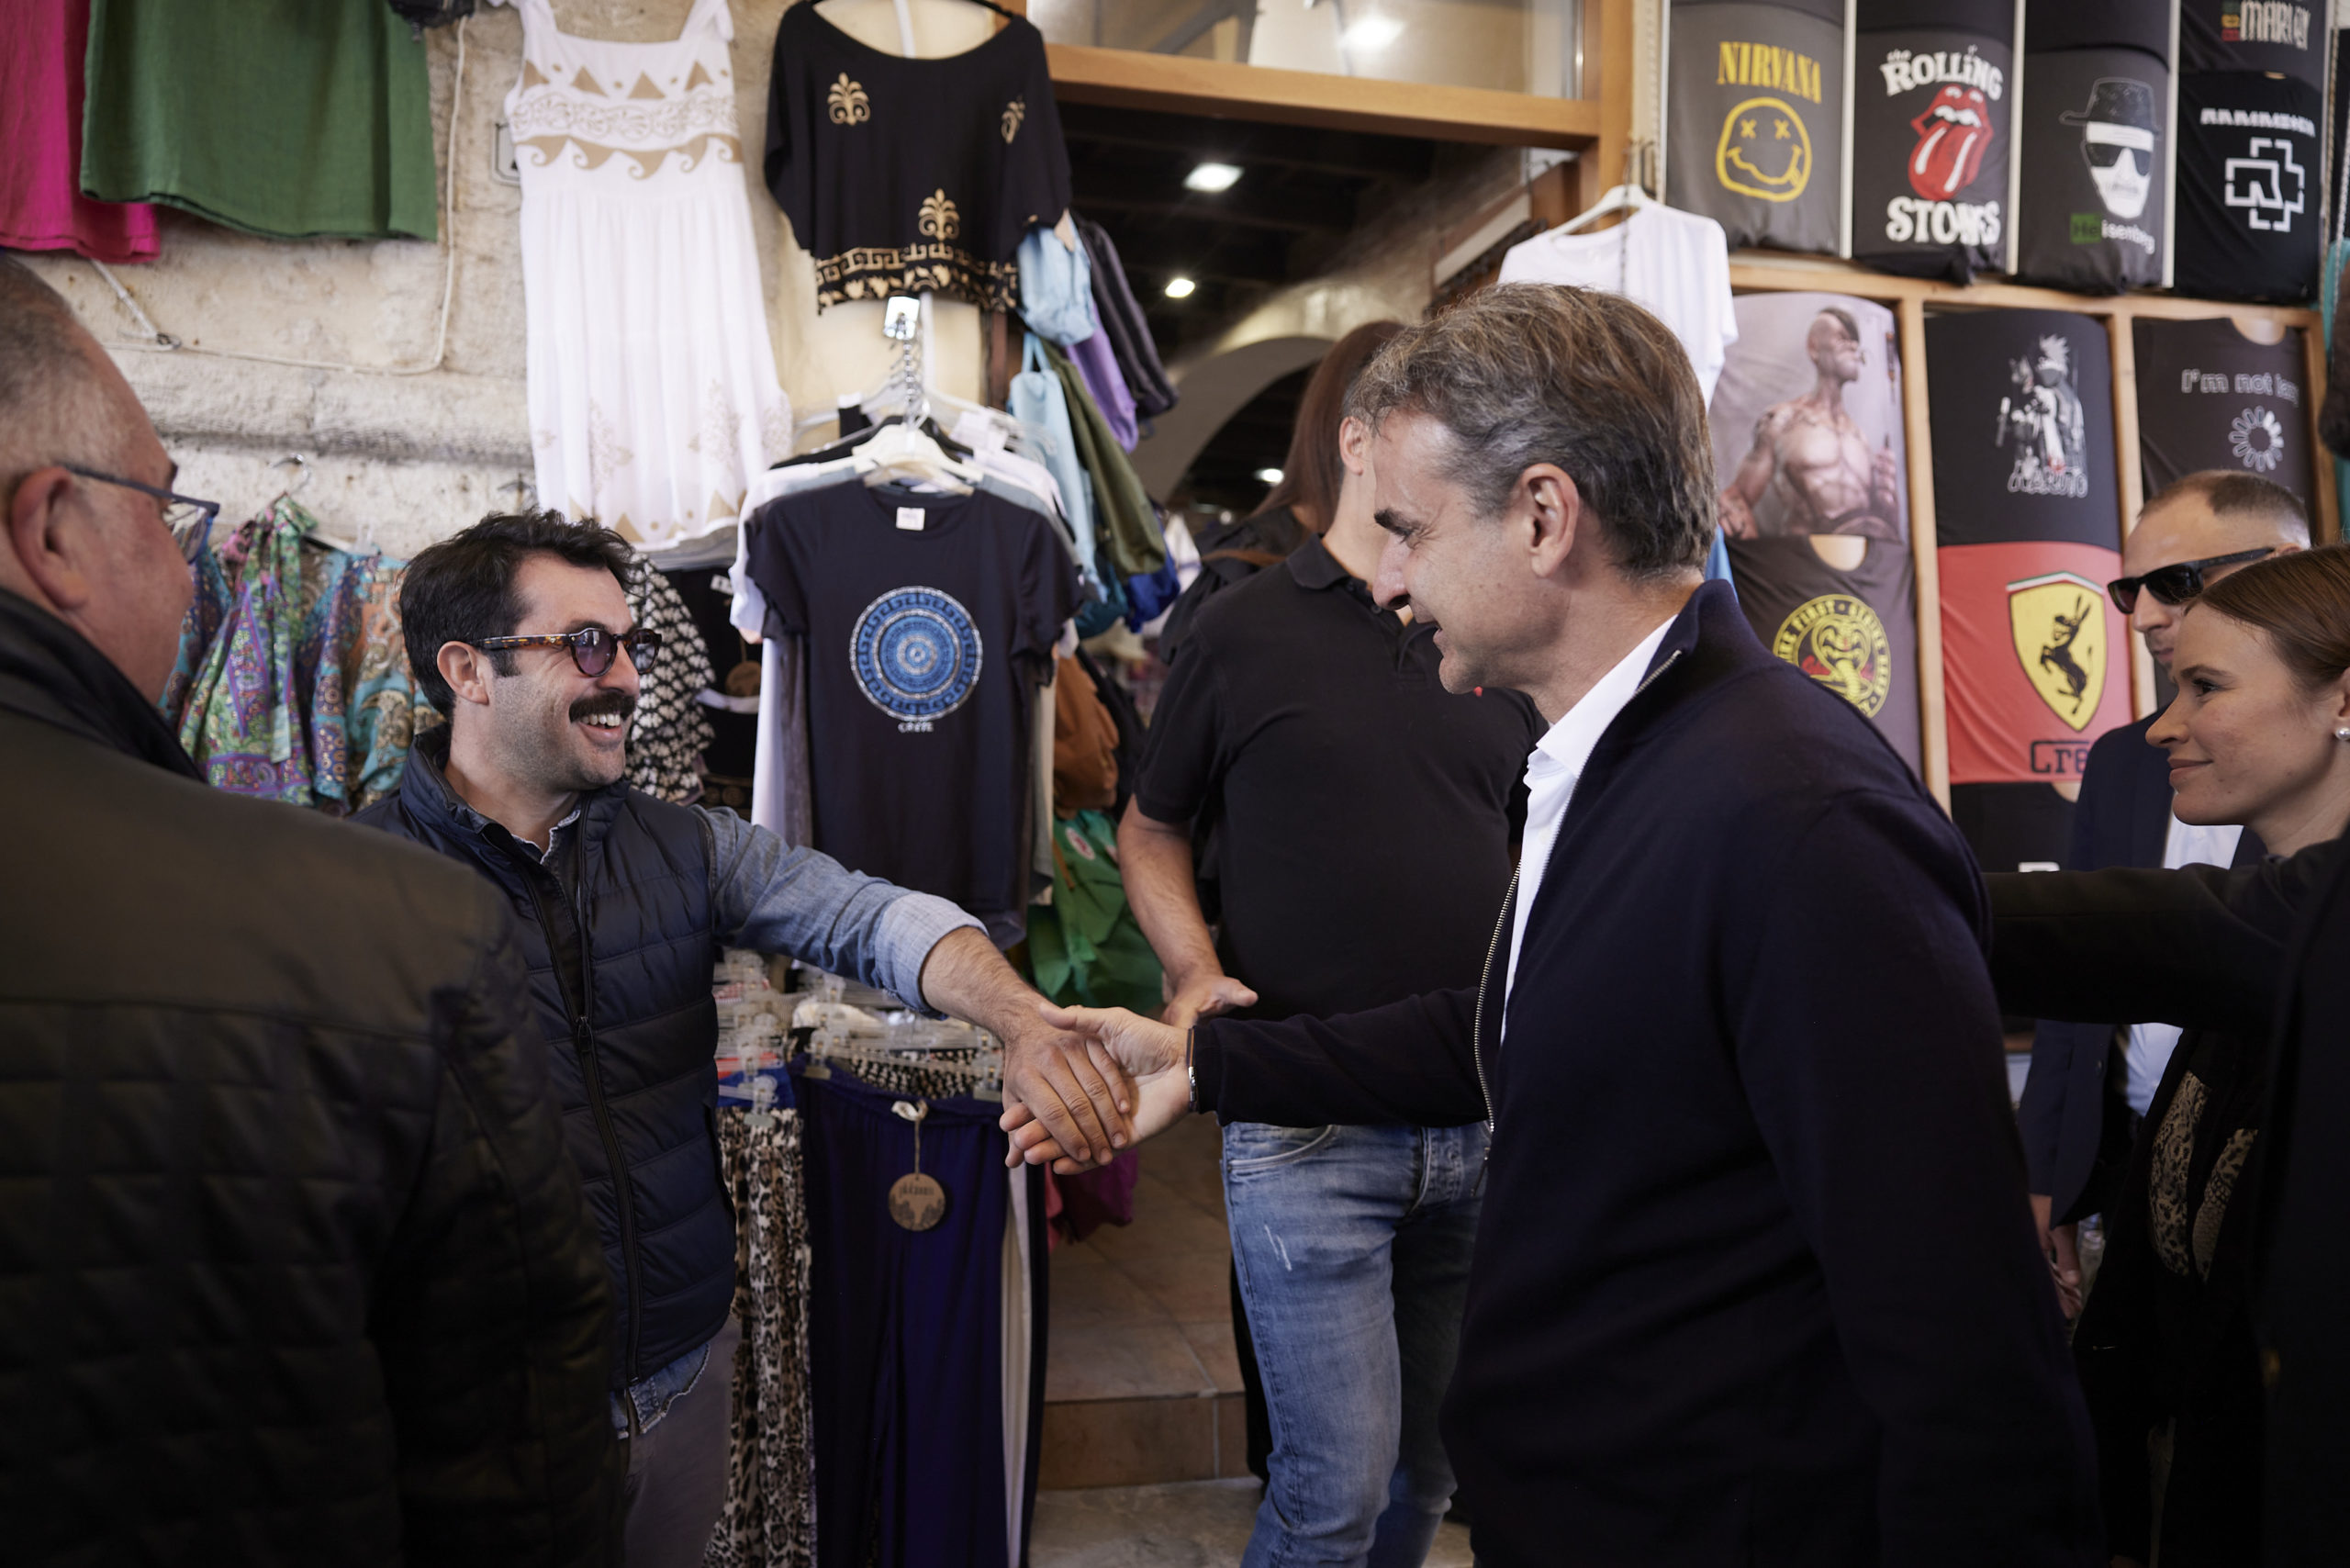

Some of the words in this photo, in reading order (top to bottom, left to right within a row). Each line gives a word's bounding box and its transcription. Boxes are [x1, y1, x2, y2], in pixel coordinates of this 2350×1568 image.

[1717, 41, 1821, 104] NIRVANA
[1886, 196, 2001, 246] STONES
[2181, 369, 2229, 393] I'm
[2234, 372, 2273, 396] not
